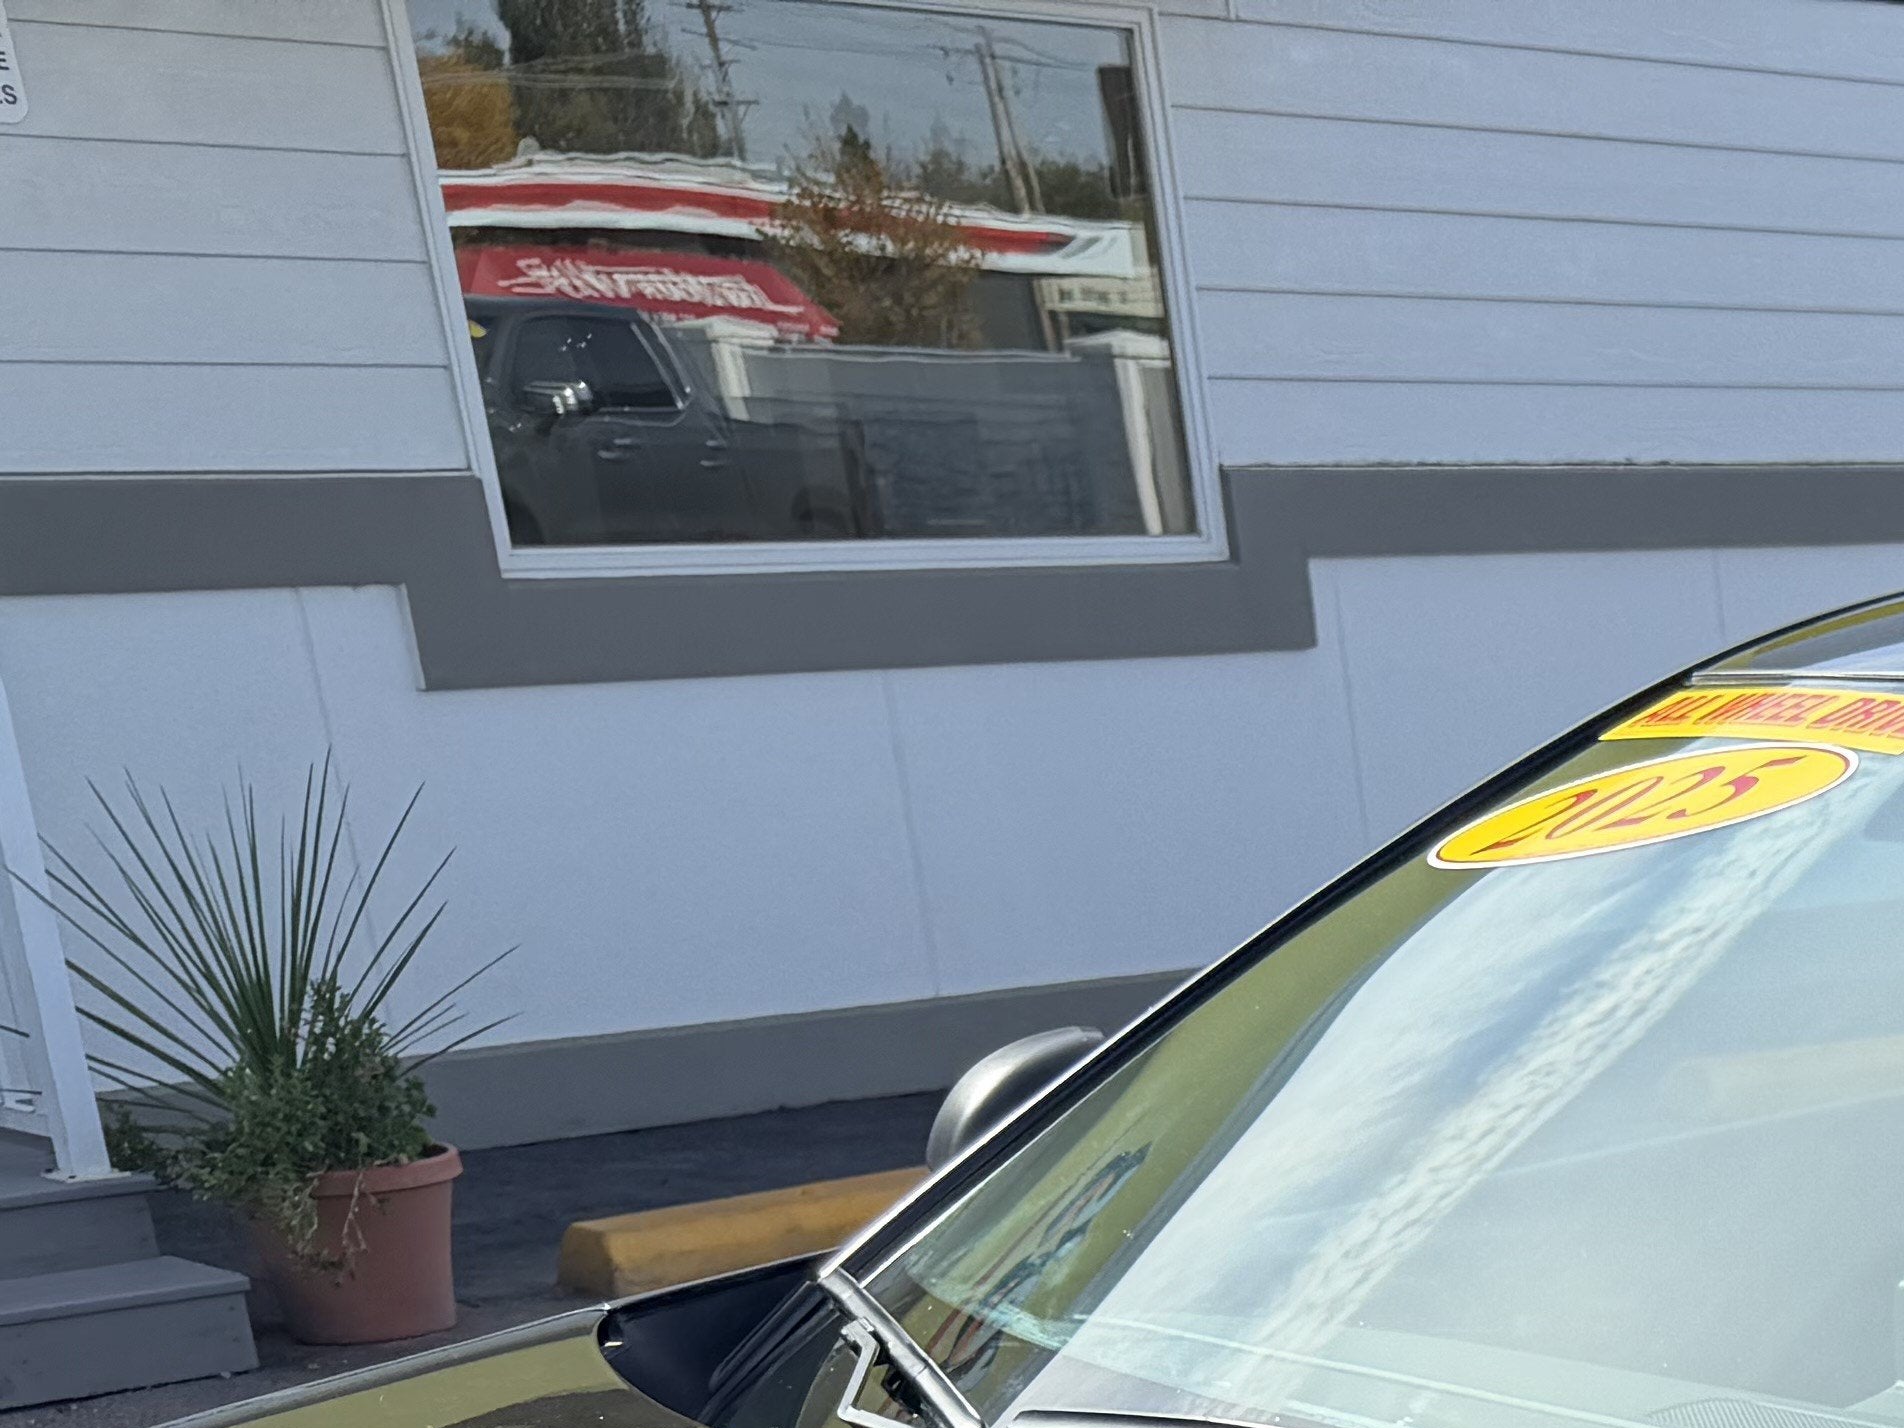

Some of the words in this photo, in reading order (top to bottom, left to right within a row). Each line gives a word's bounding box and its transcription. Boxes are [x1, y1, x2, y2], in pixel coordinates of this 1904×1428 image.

[1628, 693, 1723, 728] ALL
[1695, 692, 1838, 727] WHEEL
[1469, 756, 1808, 856] 2025
